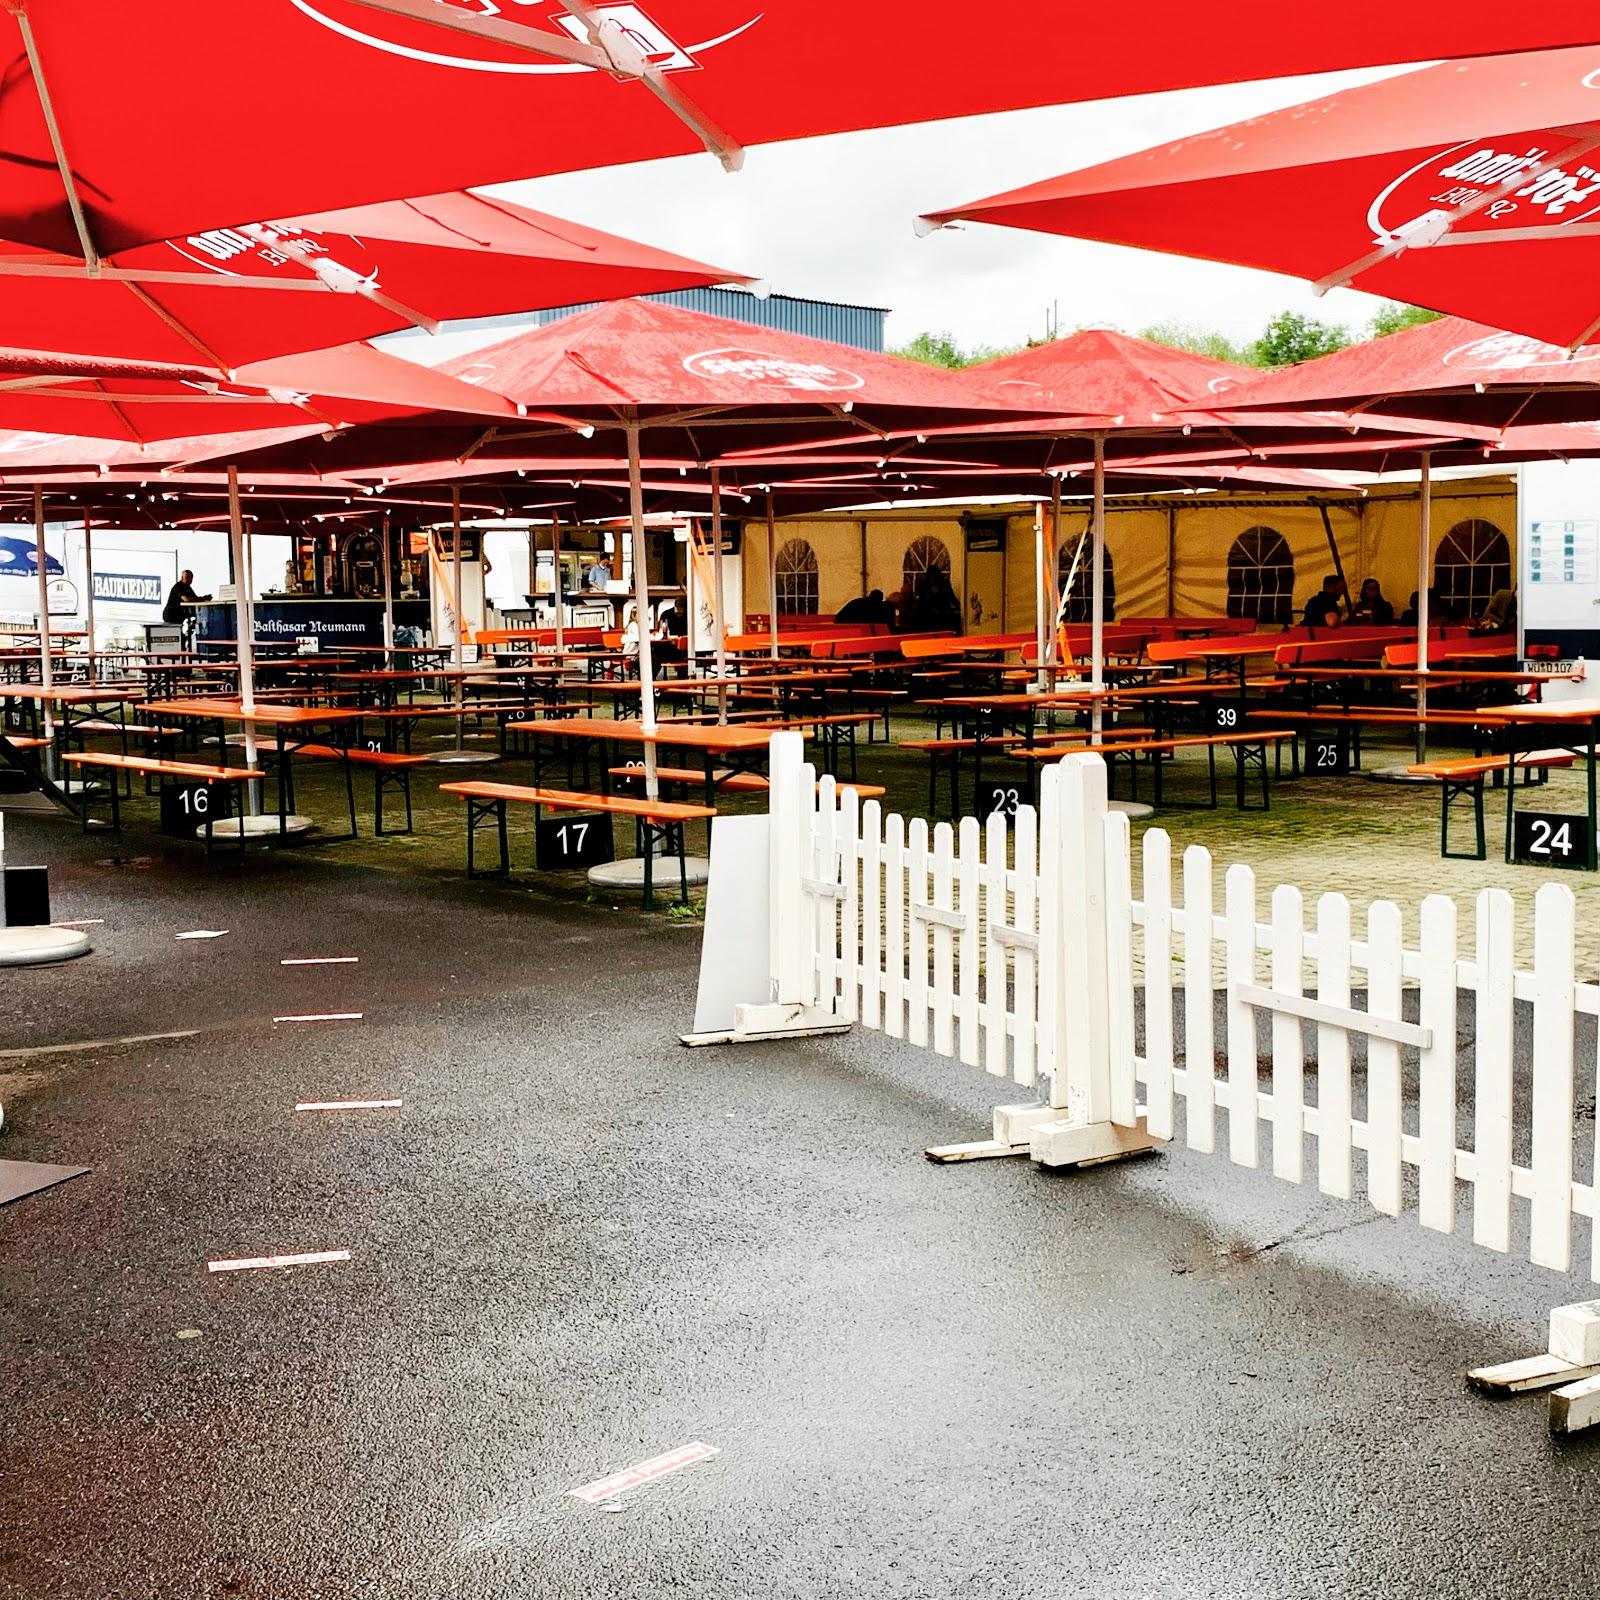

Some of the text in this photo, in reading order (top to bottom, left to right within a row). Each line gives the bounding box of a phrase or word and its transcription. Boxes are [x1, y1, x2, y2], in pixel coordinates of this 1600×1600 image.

[93, 577, 161, 600] BAURIEDEL
[253, 620, 366, 634] Balthasar Neumann
[1217, 708, 1237, 727] 39
[1317, 745, 1338, 767] 25
[178, 788, 208, 815] 16
[993, 788, 1020, 815] 23
[556, 823, 589, 855] 17
[1530, 820, 1572, 856] 24
